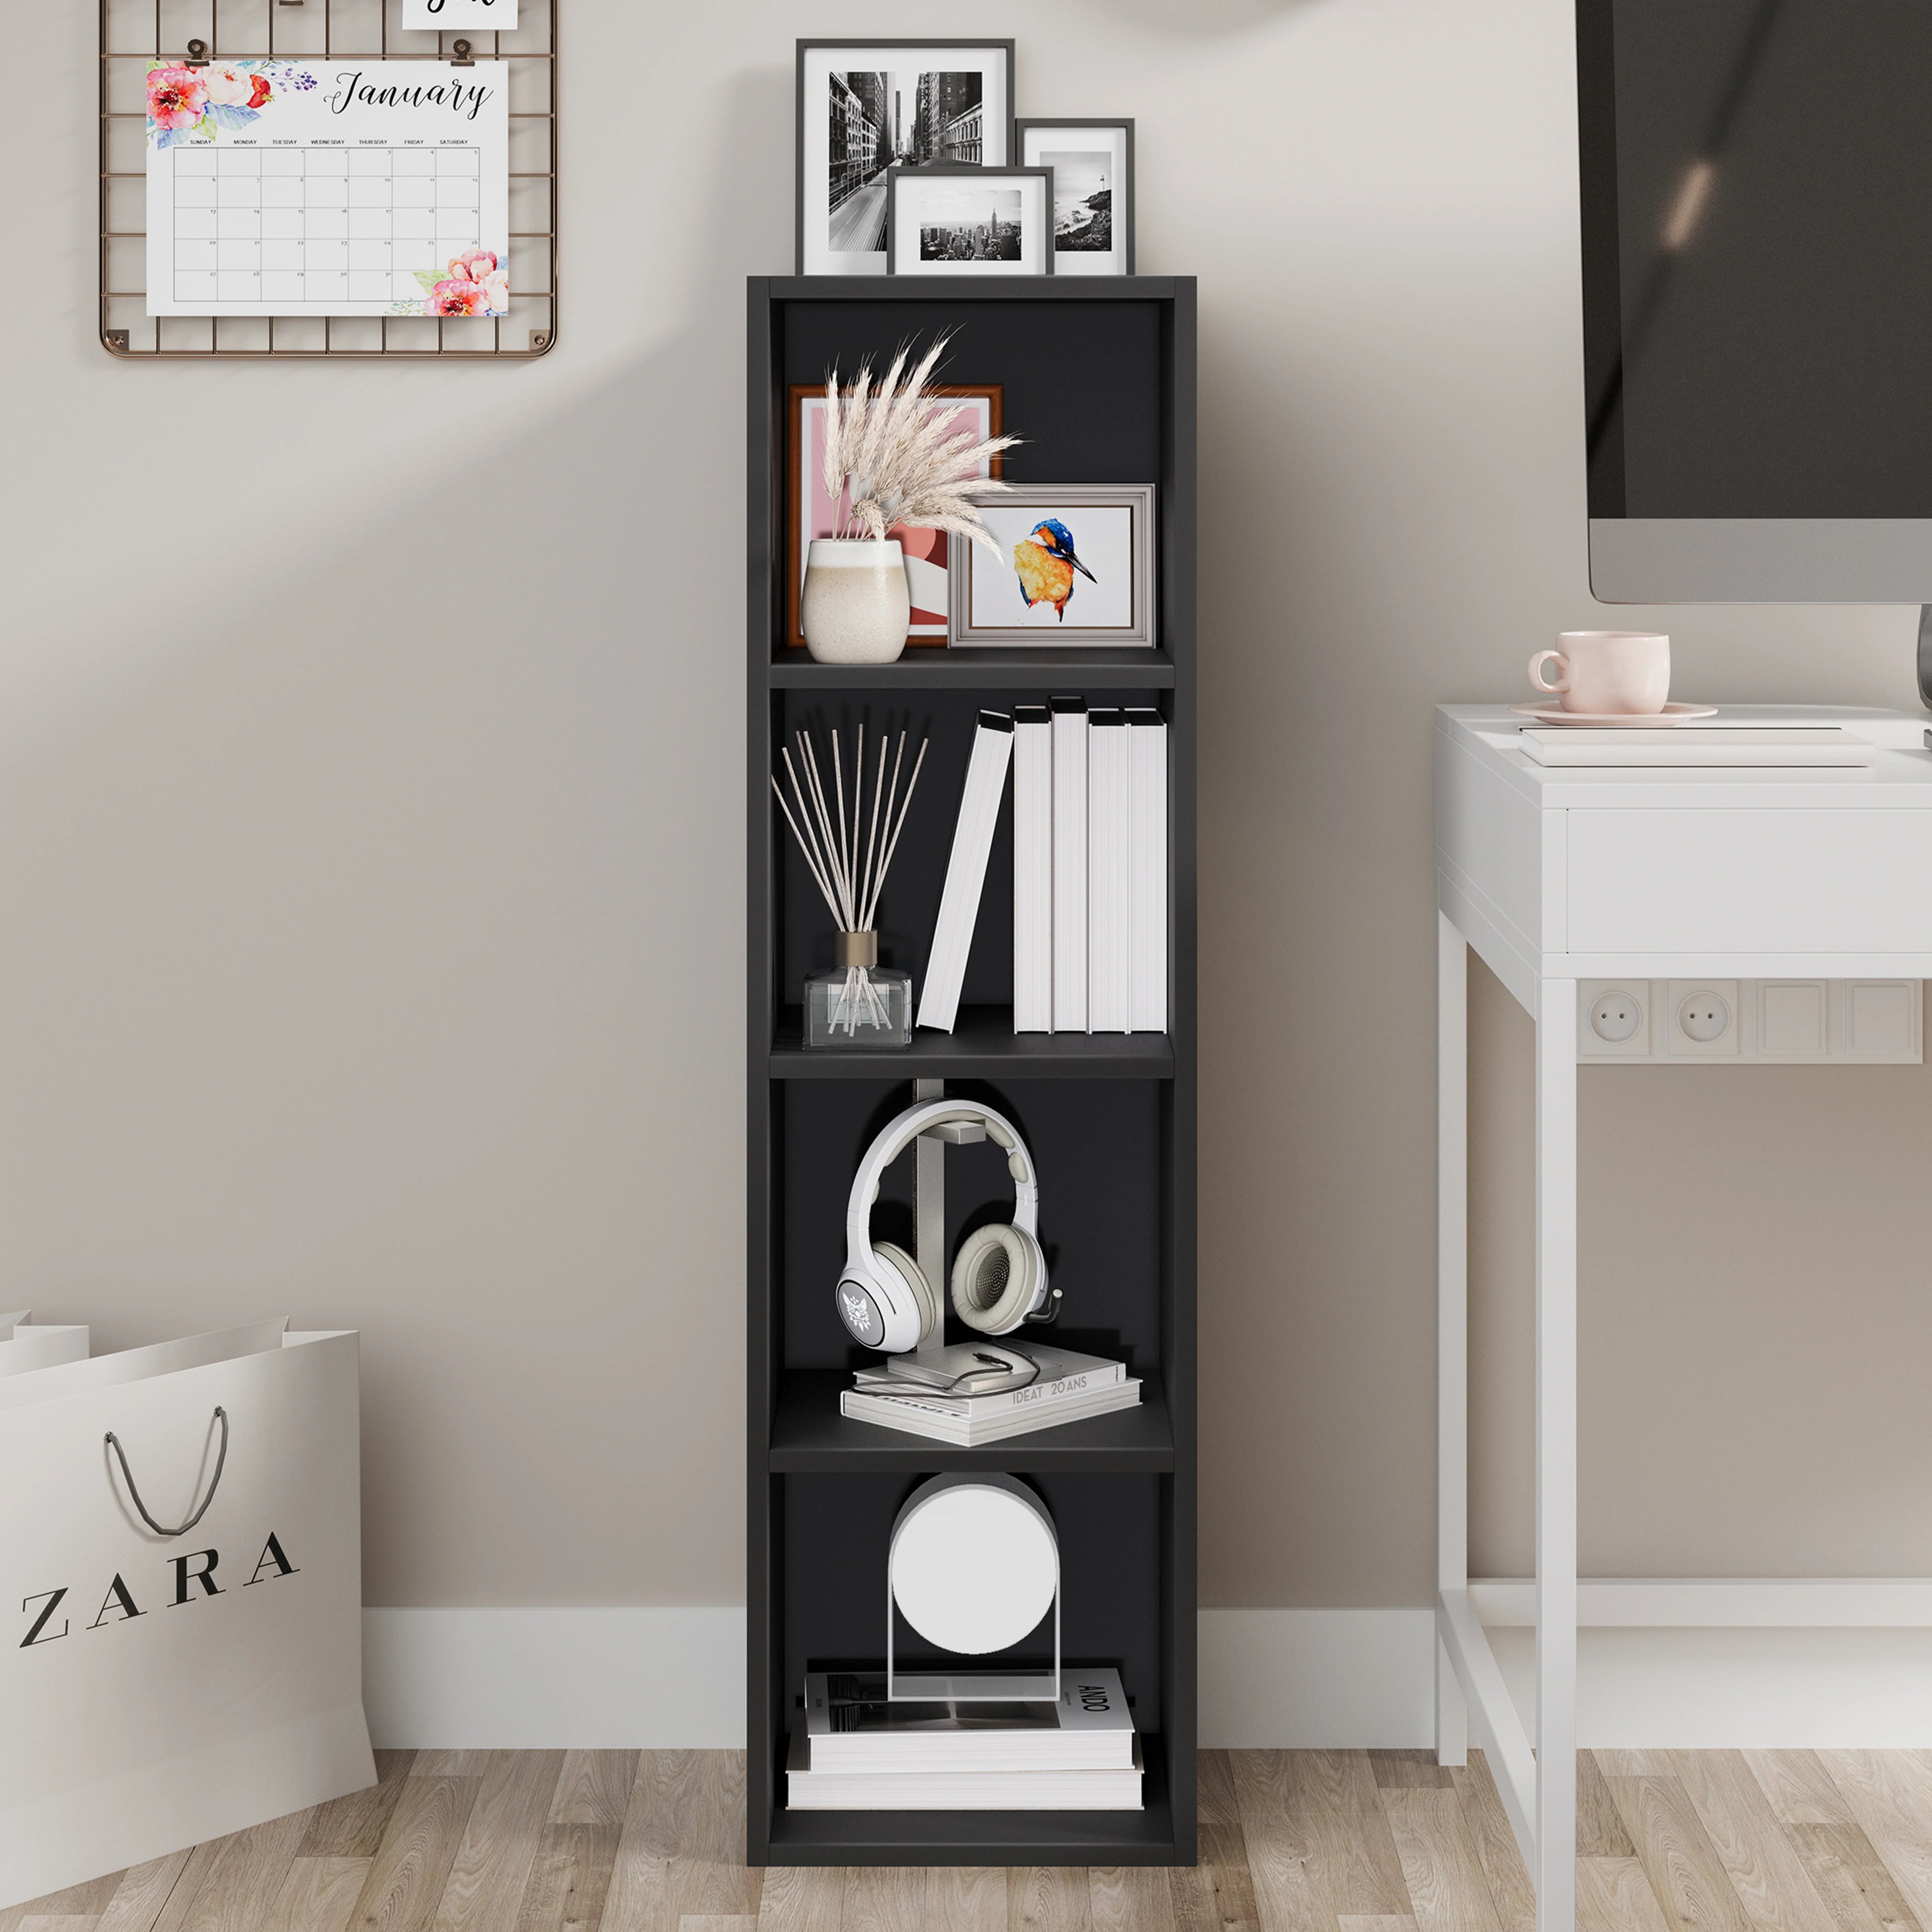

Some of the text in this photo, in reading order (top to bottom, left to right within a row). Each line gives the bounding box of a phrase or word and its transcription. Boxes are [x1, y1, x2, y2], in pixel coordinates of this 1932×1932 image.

[323, 72, 494, 120] January
[1013, 1386, 1043, 1405] IDEAT
[19, 1531, 300, 1648] ZARA
[1078, 1685, 1110, 1712] ANDO
